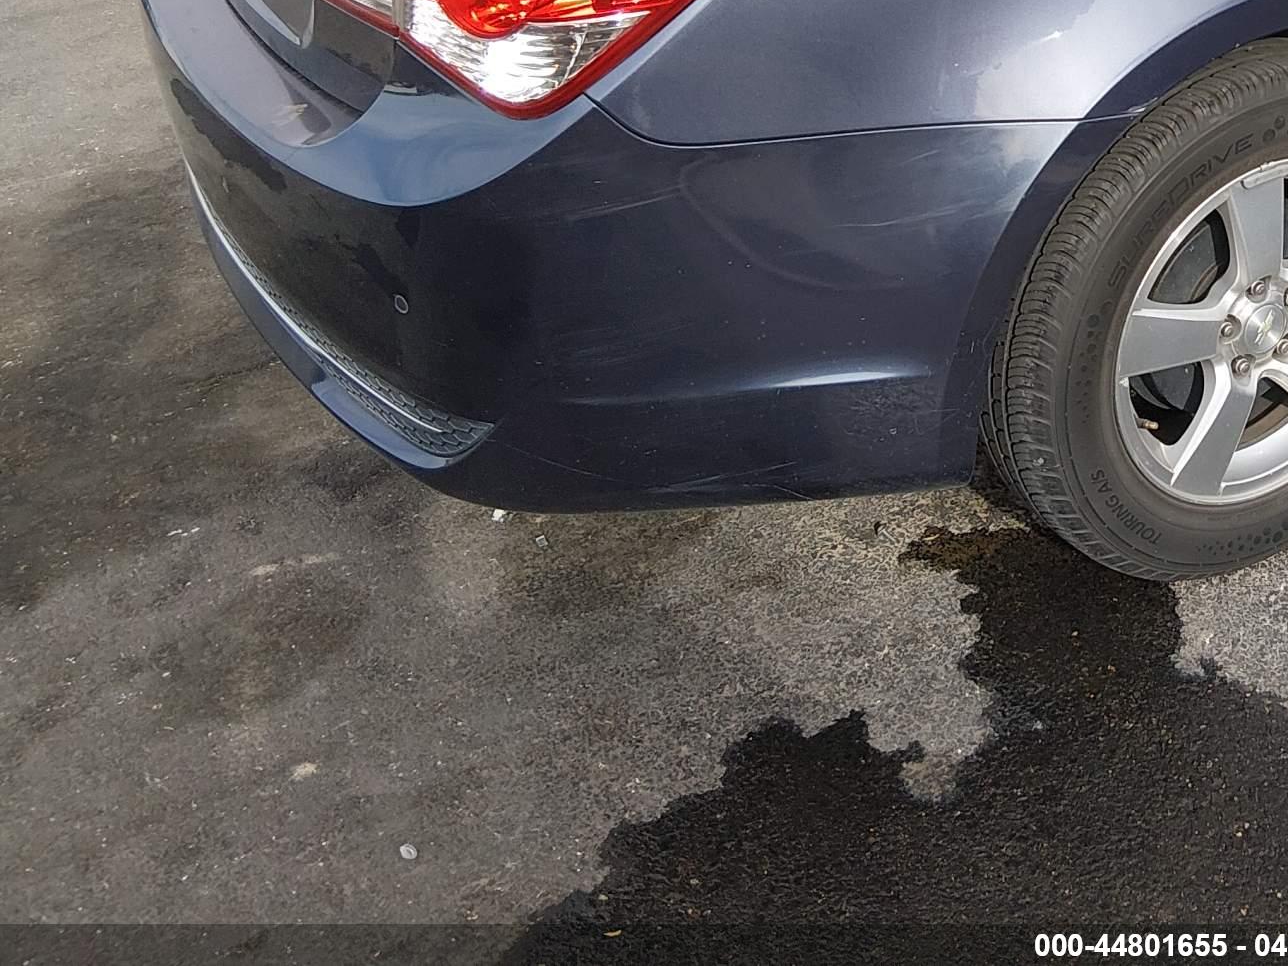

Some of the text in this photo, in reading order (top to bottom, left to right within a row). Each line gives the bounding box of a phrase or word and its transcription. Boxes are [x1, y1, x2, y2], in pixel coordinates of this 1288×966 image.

[1106, 131, 1254, 289] SUREDRIVE
[1090, 469, 1163, 545] TOURING A/S
